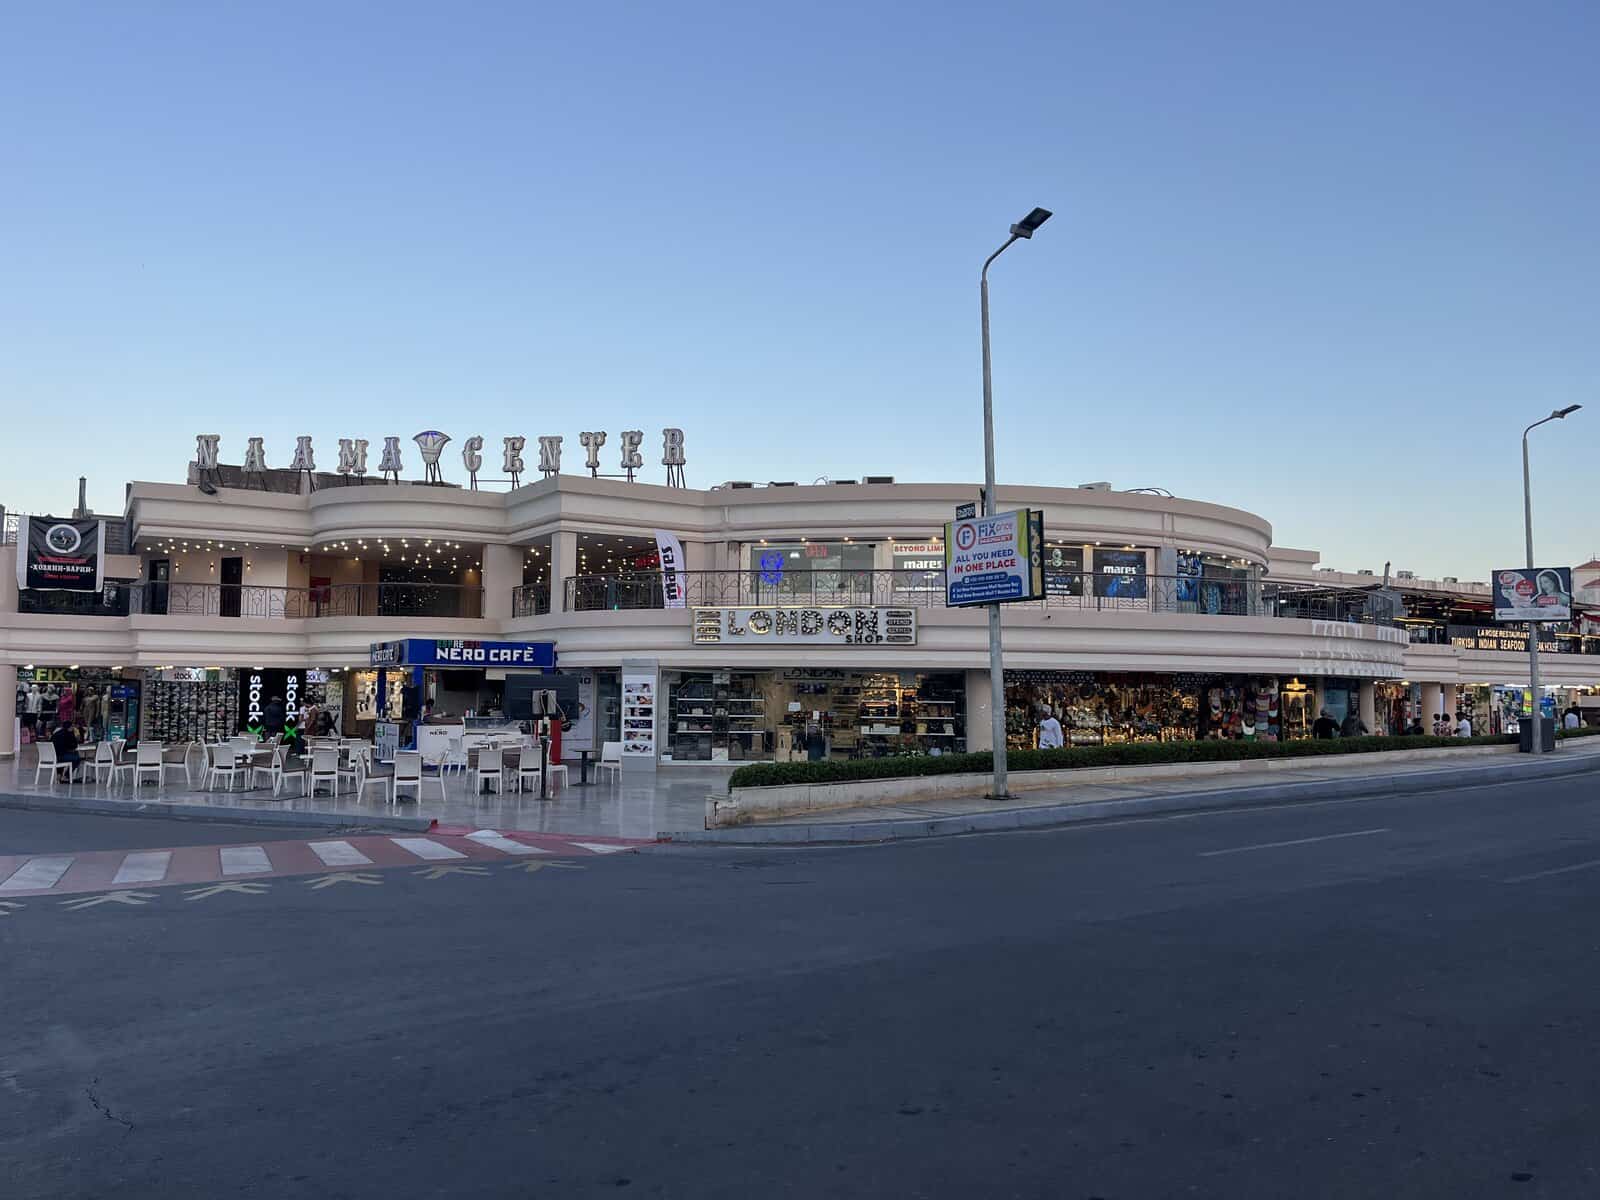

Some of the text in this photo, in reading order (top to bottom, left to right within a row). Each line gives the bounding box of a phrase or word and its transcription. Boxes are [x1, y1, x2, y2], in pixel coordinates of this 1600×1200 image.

[195, 428, 686, 473] NAAMA CENTER
[956, 549, 1014, 563] ALL YOU NEED
[903, 560, 942, 569] mares
[954, 559, 1016, 574] IN ONE PLACE
[1103, 565, 1136, 574] mares
[662, 546, 678, 600] mares
[728, 610, 879, 636] LONDON
[845, 635, 883, 643] SHOP
[1451, 637, 1475, 649] TURKISH
[1479, 638, 1497, 649] INDIAN
[1500, 640, 1525, 651] SEAFOOD
[436, 647, 485, 661] NERO
[36, 668, 66, 681] FIX
[174, 671, 192, 680] stock
[249, 675, 264, 722] stock
[285, 675, 299, 722] stock
